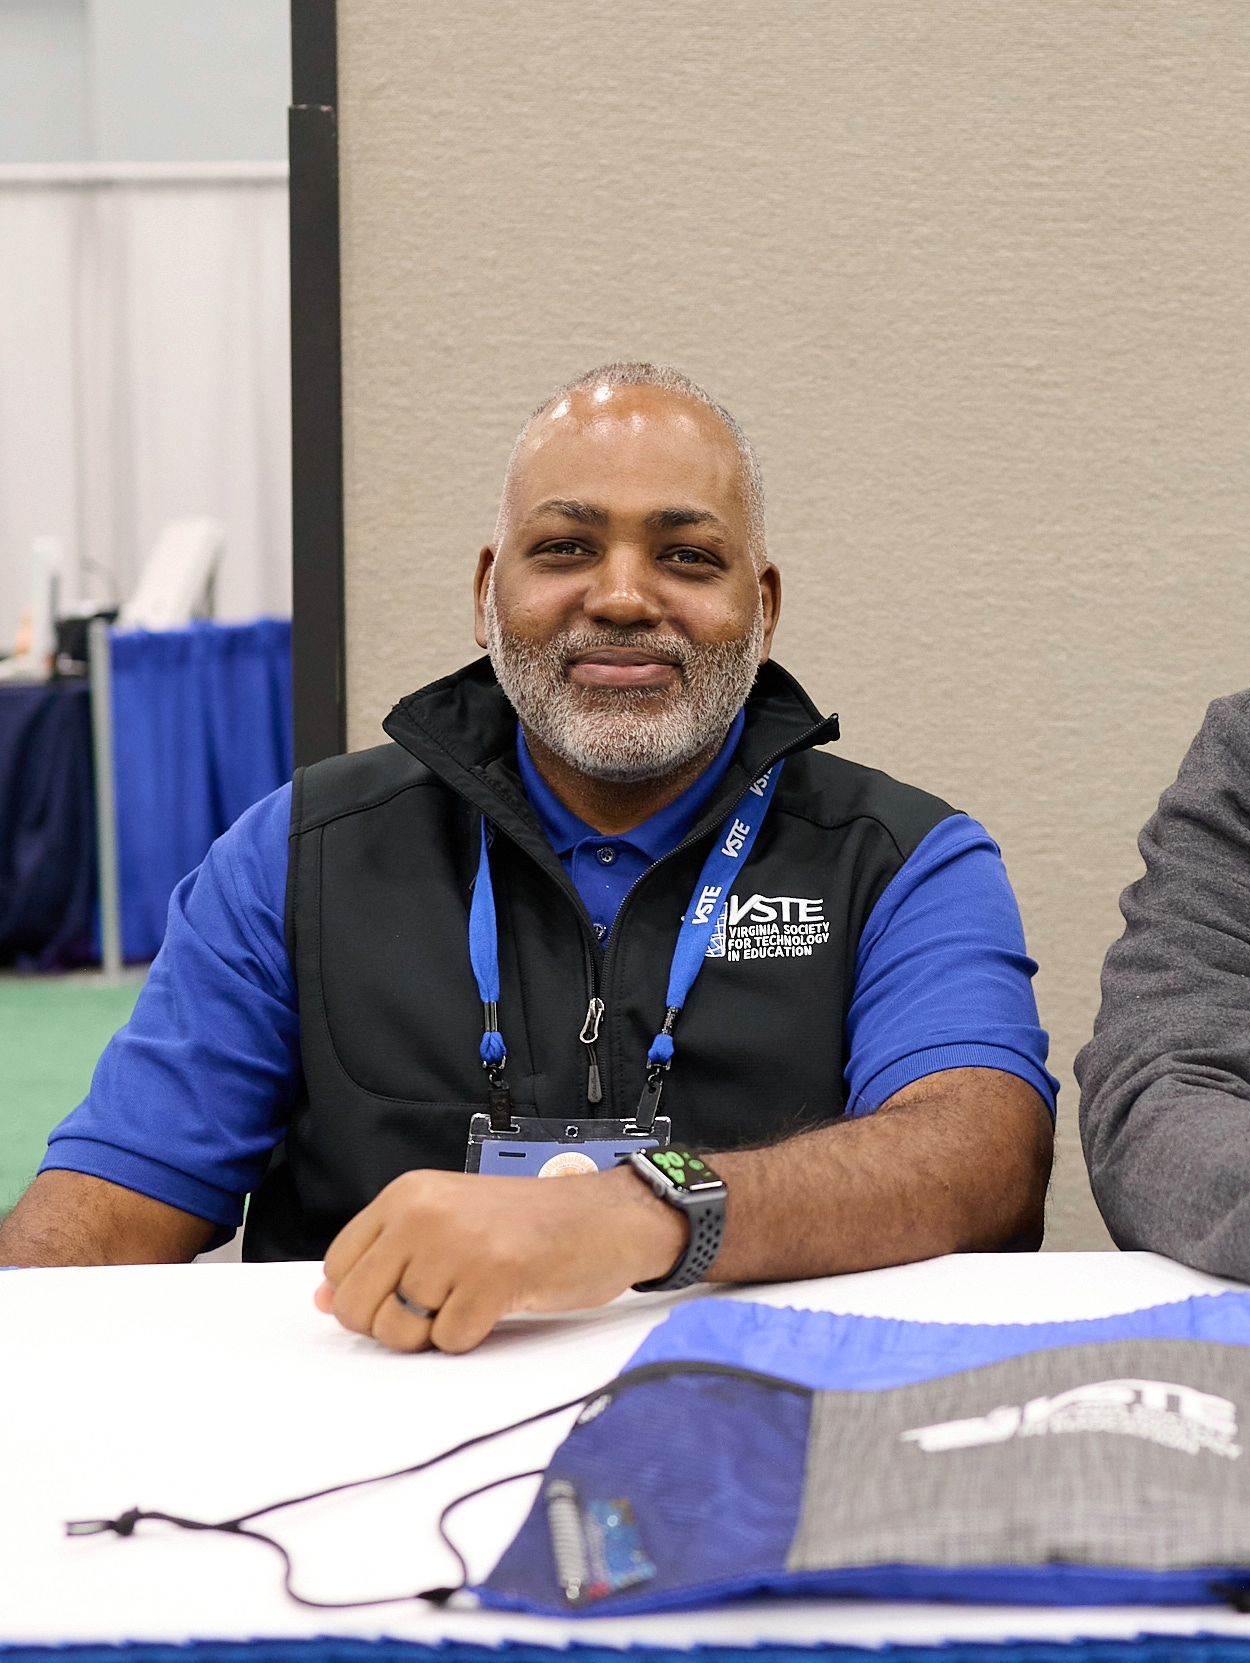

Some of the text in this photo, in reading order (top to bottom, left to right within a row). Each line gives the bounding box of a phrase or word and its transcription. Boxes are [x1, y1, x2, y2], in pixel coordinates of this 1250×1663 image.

[722, 818, 750, 858] VSTE
[692, 885, 722, 925] VSTE
[728, 893, 825, 926] VSTE
[727, 932, 830, 951] FOR TECHNOLOGY
[728, 921, 830, 939] VIRGINIA SOCIETY
[727, 945, 813, 962] IN EDUCATION
